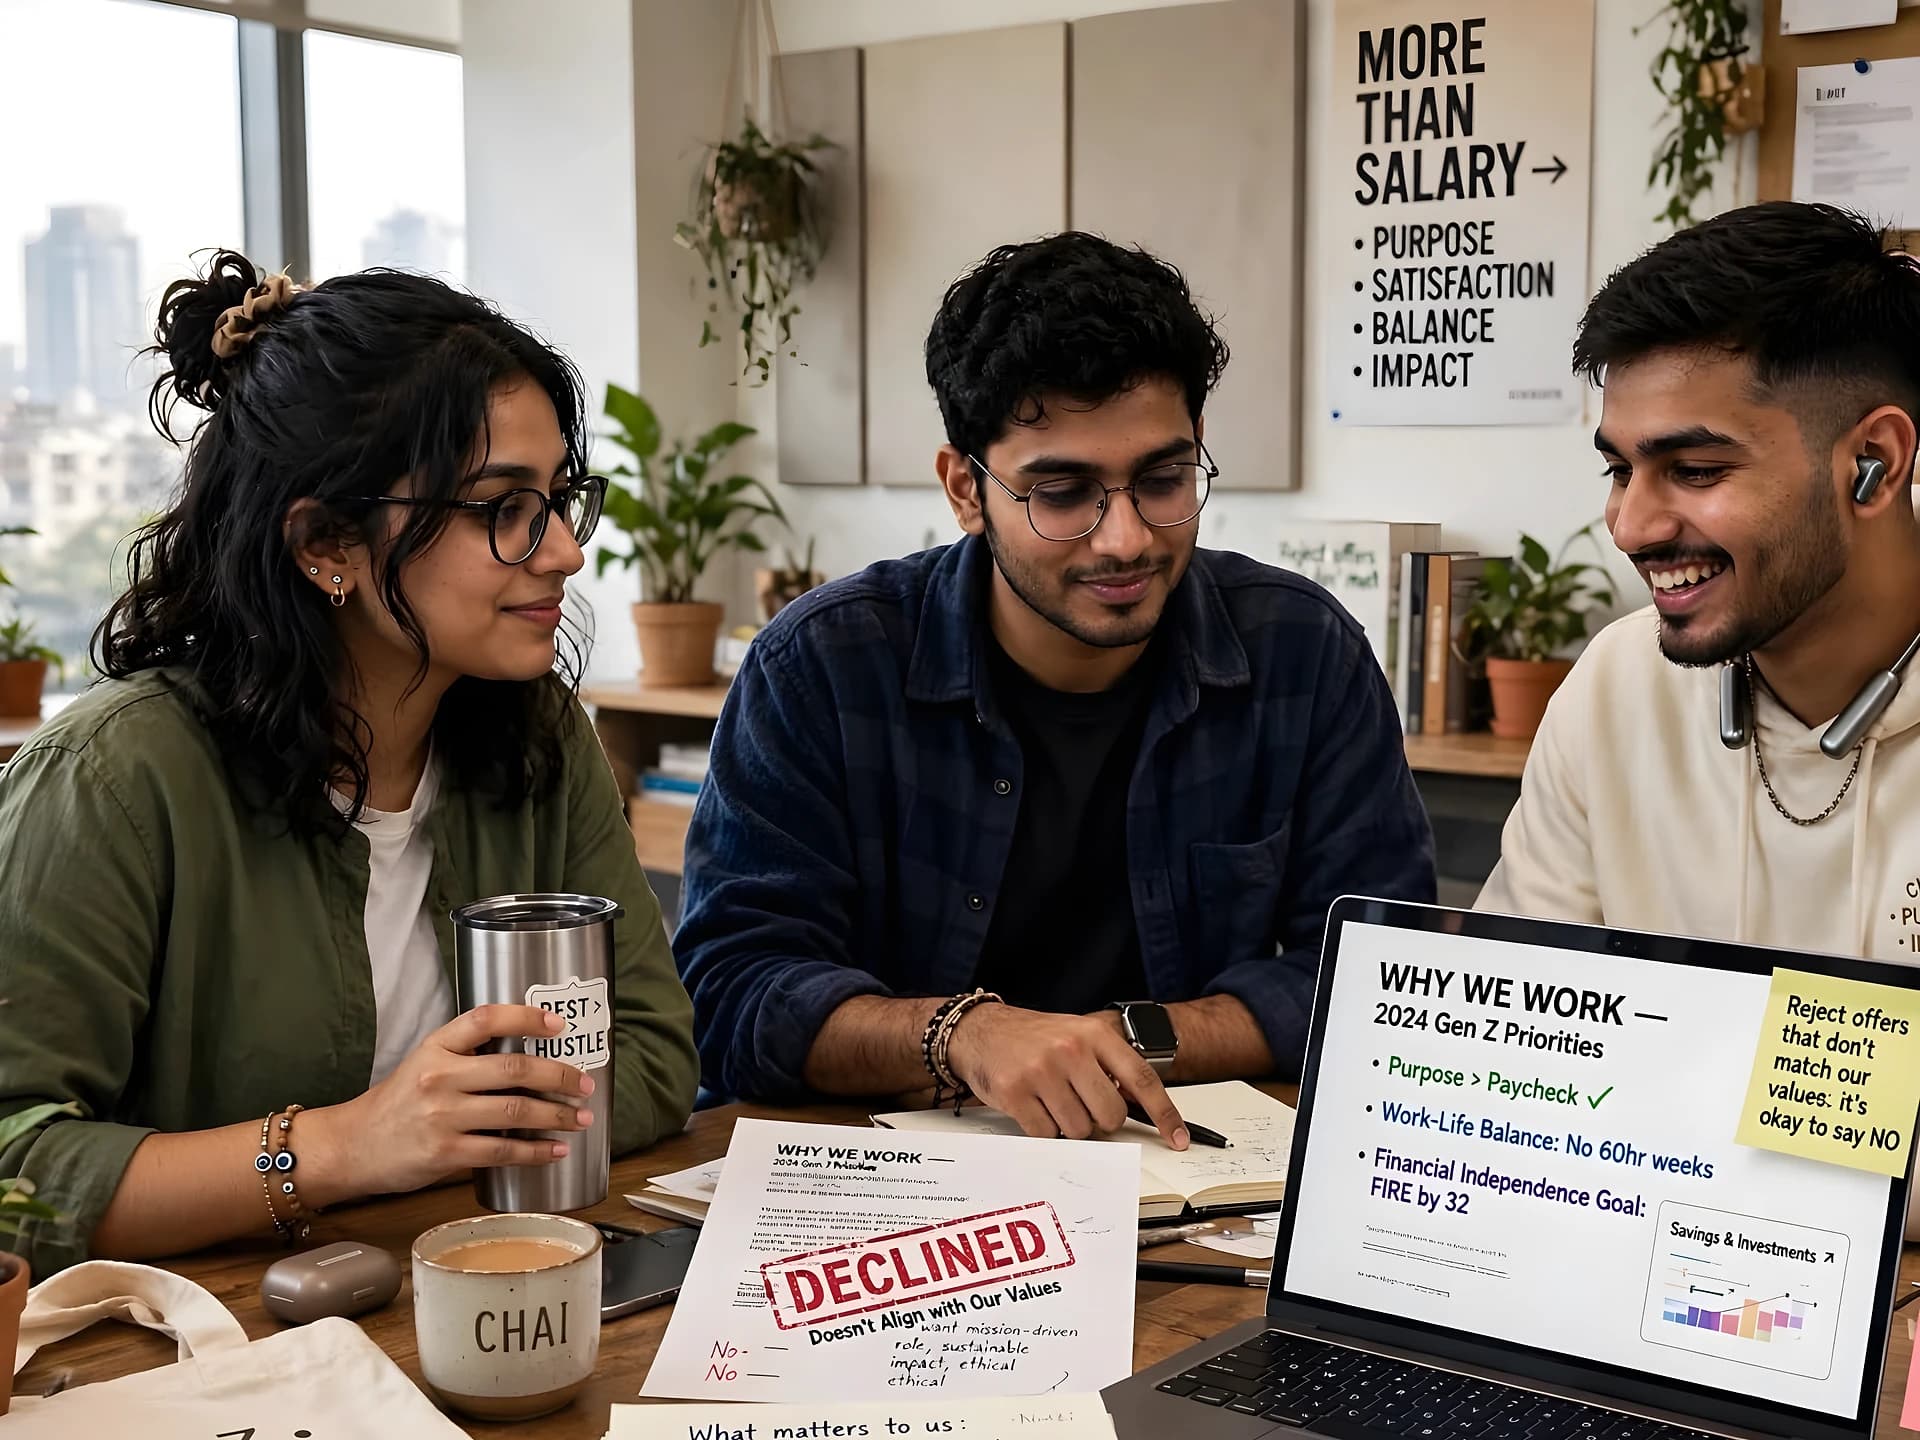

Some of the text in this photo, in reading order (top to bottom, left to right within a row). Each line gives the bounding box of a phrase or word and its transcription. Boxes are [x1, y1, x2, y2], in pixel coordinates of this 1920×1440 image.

[1358, 18, 1486, 84] MORE
[1356, 82, 1474, 145] THAN
[1355, 141, 1526, 205] SALARY
[1373, 221, 1495, 259] PURPOSE
[1372, 261, 1554, 302] SATISFACTION
[1372, 308, 1495, 345] BALANCE
[1372, 352, 1473, 388] IMPACT
[1380, 961, 1455, 998] WHY
[1463, 973, 1514, 1008] WE
[1522, 981, 1627, 1026] WORK
[1373, 1002, 1604, 1059] 2024 Gen Z Priorities
[1786, 994, 1909, 1035] Reject offers
[535, 1030, 605, 1059] HUSTLE
[1781, 1023, 1876, 1059] that don't
[1388, 1056, 1579, 1106] Purpose > Paycheck
[1774, 1055, 1871, 1086] match our
[1839, 1091, 1868, 1115] it's
[1382, 1101, 1714, 1180] Work-Life Balance: No 60hr weeks
[1759, 1106, 1901, 1151] okay to say NO
[777, 1143, 823, 1157] WHY
[828, 1147, 859, 1160] WE
[863, 1149, 922, 1165] WORK
[1370, 1176, 1470, 1215] FIRE by 32
[1374, 1148, 1647, 1218] Financial Independence Goal:
[1670, 1221, 1817, 1264] Savings & Investments
[784, 1218, 1048, 1314] DECLINED
[474, 1301, 569, 1354] CHAI
[808, 1281, 1063, 1346] Doesn't Align with Our Values
[921, 1321, 1080, 1337] want mission-driven
[889, 1355, 1017, 1374] impact, ethical
[894, 1337, 1030, 1355] role, sustainable
[704, 1363, 738, 1382] No
[887, 1373, 946, 1387] ethical
[688, 1423, 757, 1440] What
[773, 1420, 870, 1440] matters
[884, 1417, 911, 1435] to
